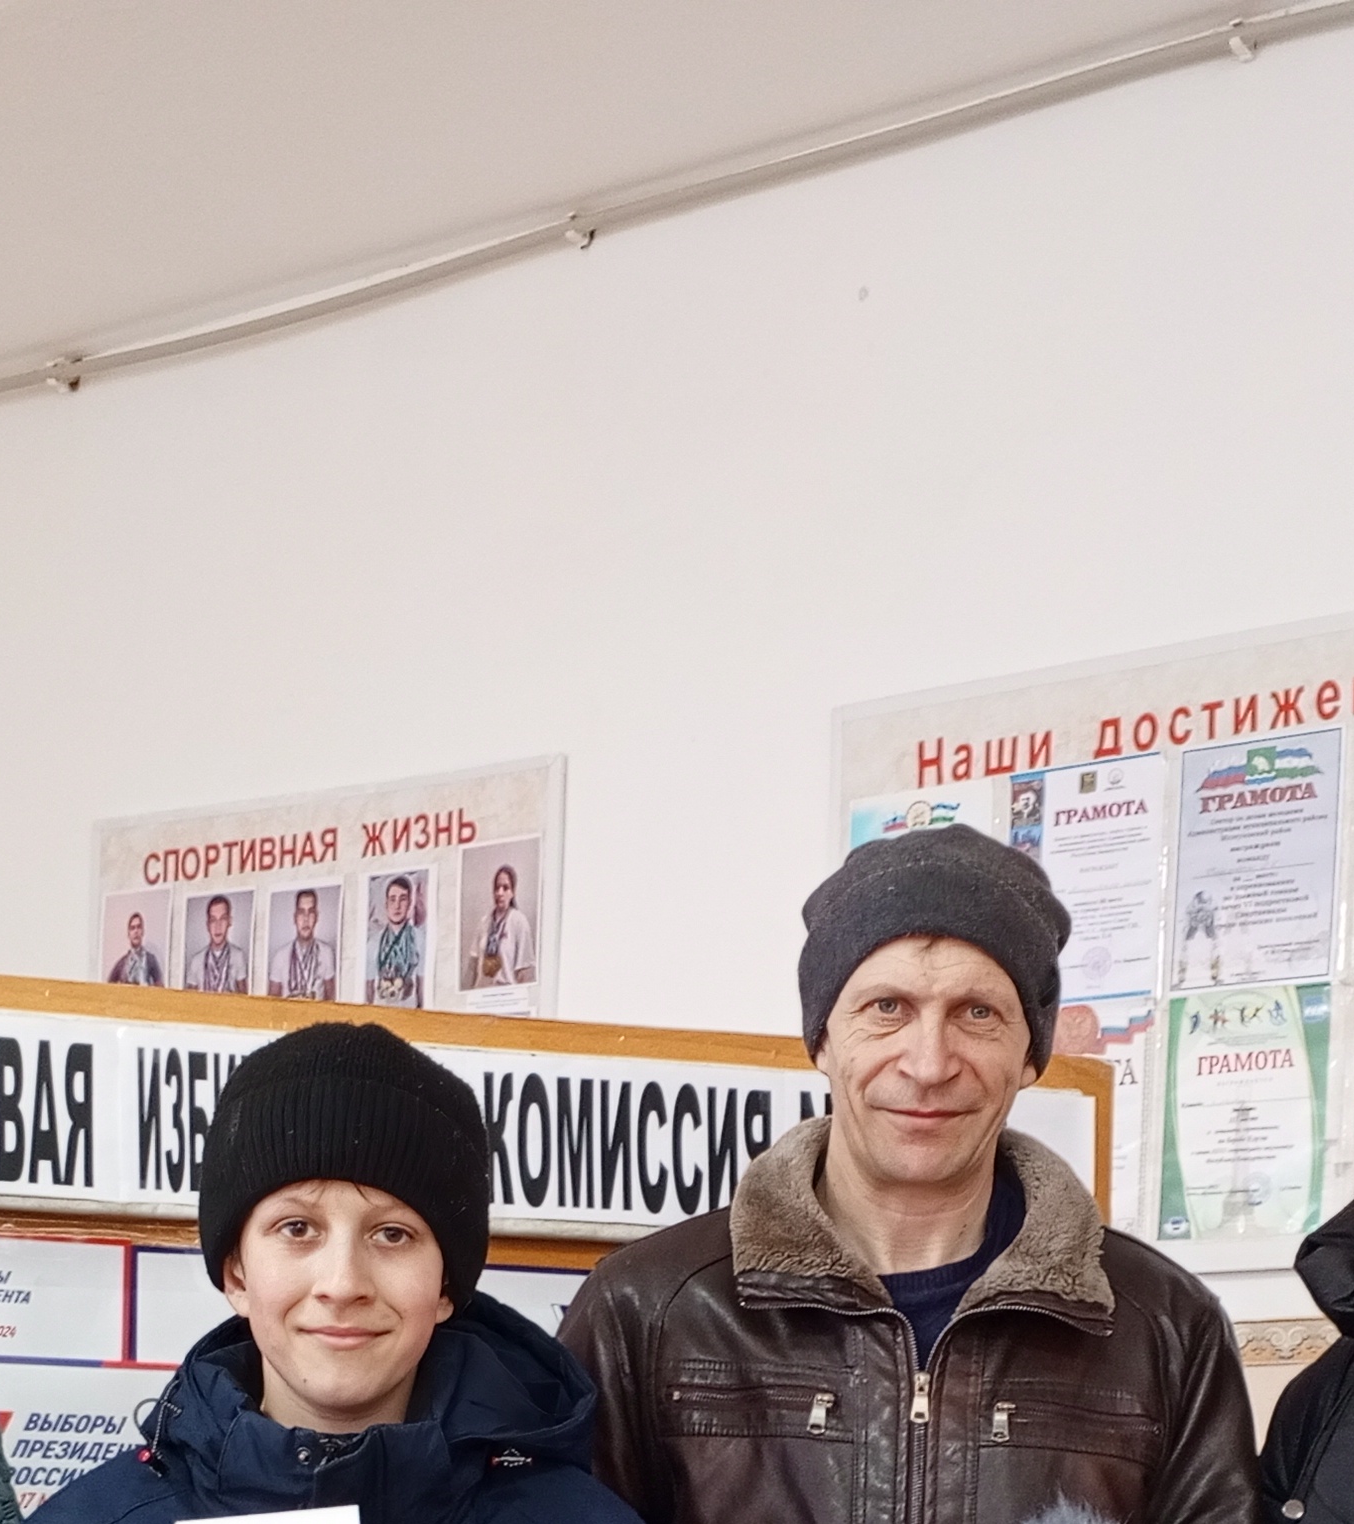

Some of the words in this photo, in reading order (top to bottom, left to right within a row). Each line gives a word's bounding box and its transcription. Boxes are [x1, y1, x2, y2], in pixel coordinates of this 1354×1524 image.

[916, 729, 1054, 788] Наши
[1199, 781, 1319, 815] ГРАМОТА
[1053, 799, 1149, 828] ГРАМОТА
[143, 827, 339, 886] СПОРТИВНАЯ
[360, 807, 478, 859] ЖИЗНЬ
[1196, 1048, 1296, 1077] ГРАМОТА
[23, 1412, 128, 1436] ВЫБОРЫ
[10, 1438, 145, 1464] ПРЕЗИДЕ
